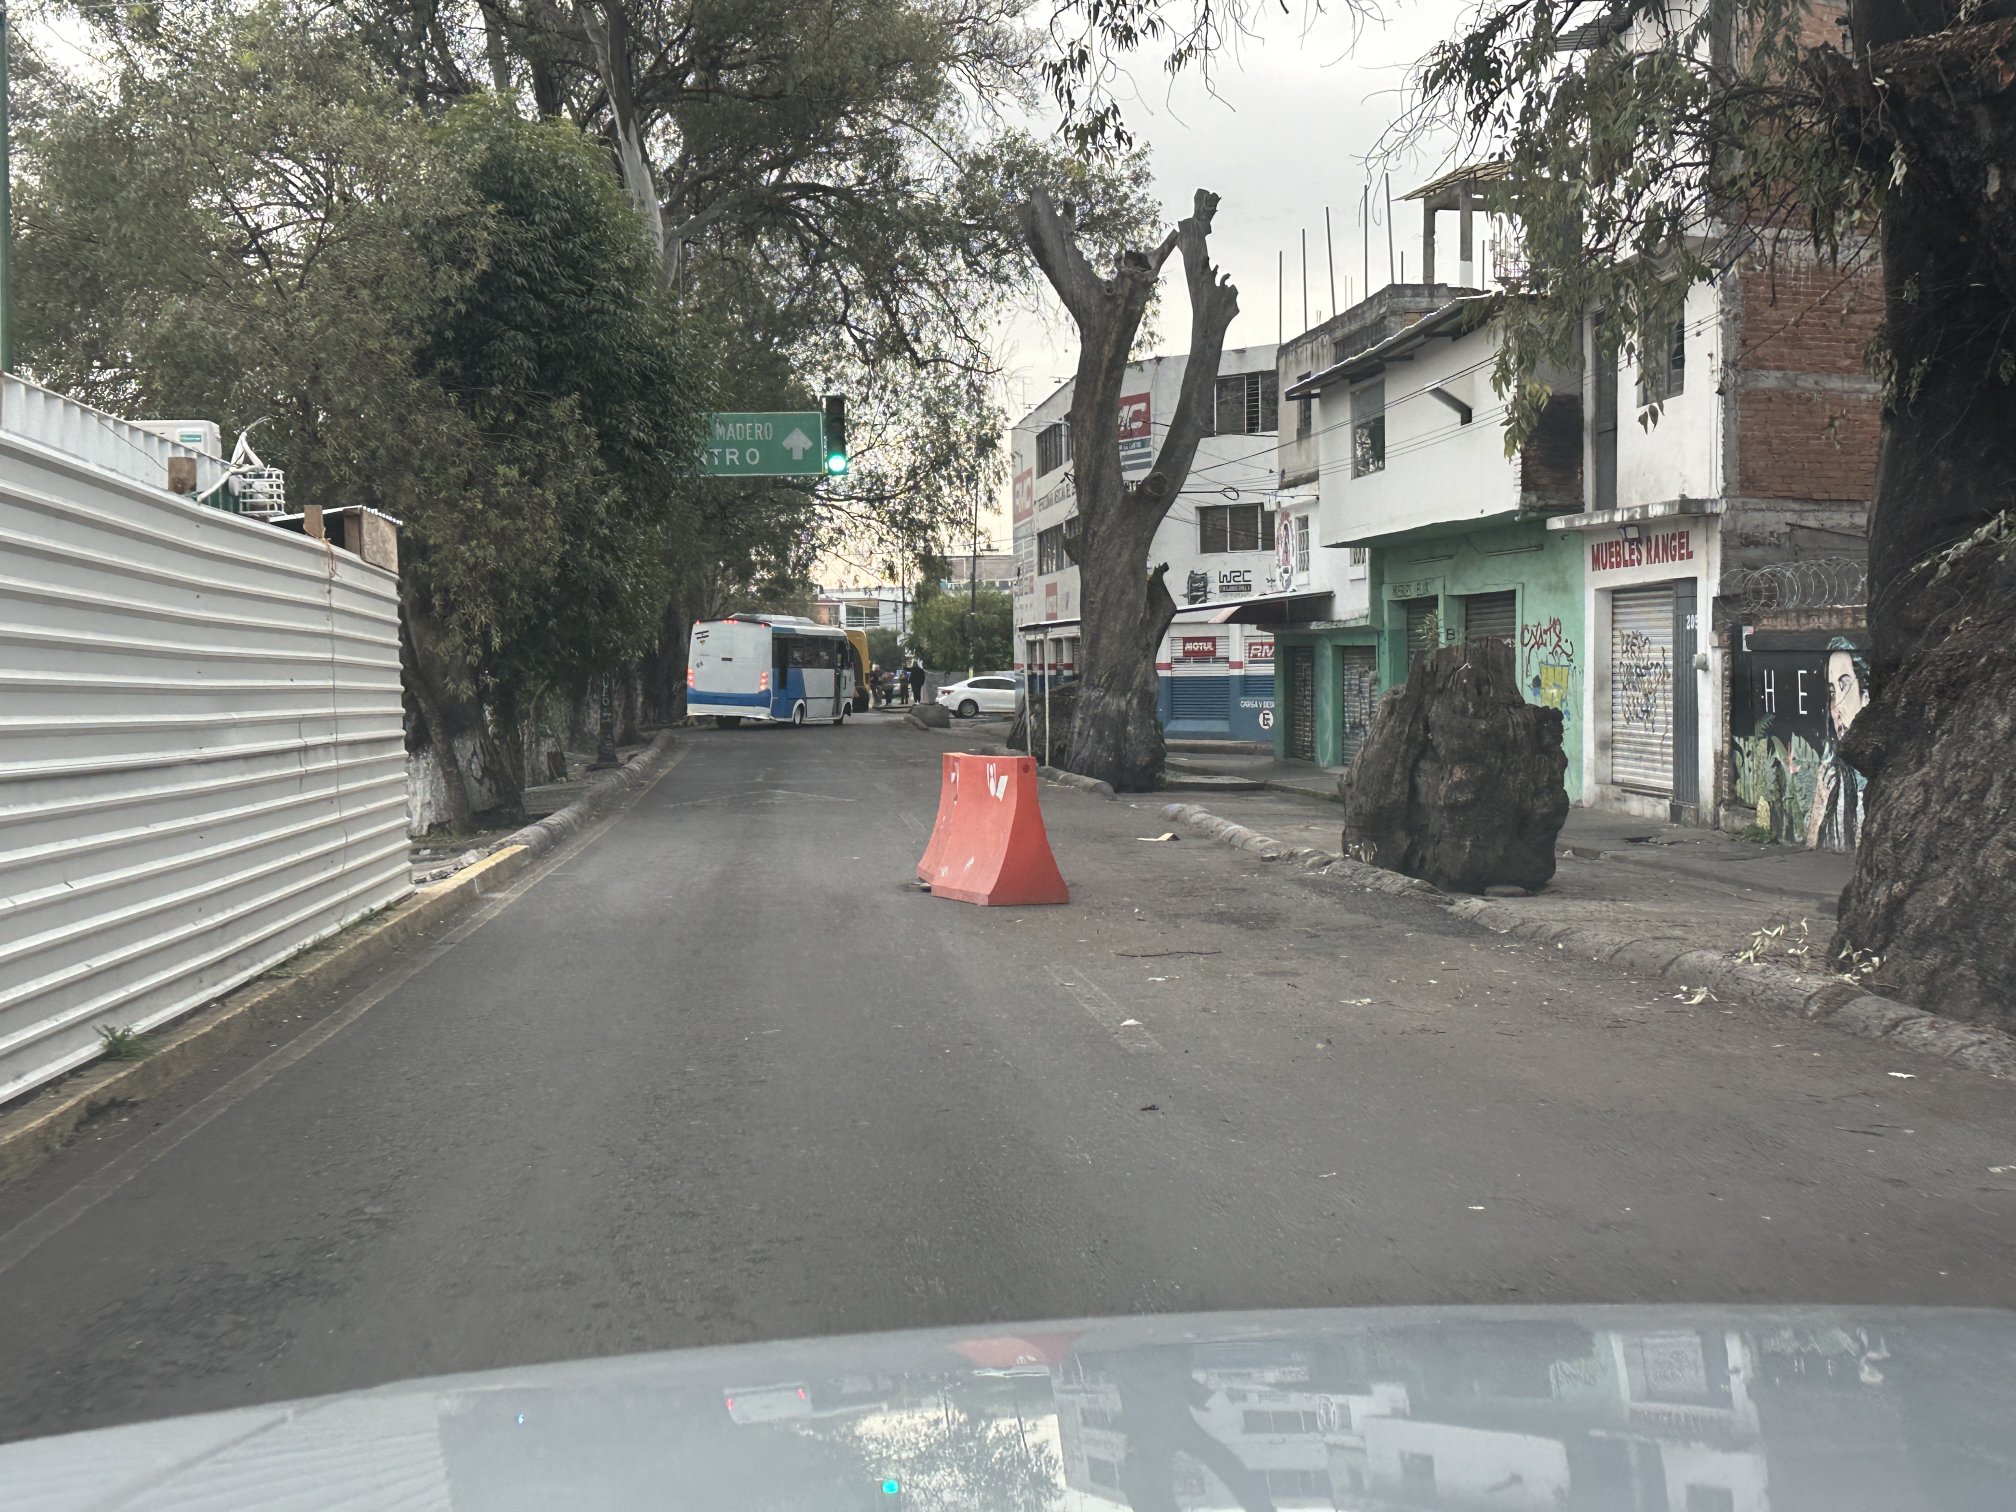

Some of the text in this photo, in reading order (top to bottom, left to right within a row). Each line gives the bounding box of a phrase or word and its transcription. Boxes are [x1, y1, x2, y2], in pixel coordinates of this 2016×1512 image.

[716, 422, 773, 440] MADERO
[1592, 530, 1694, 571] MUEBLES RANGEL
[1184, 641, 1214, 652] MOTUL
[1250, 645, 1274, 657] RM
